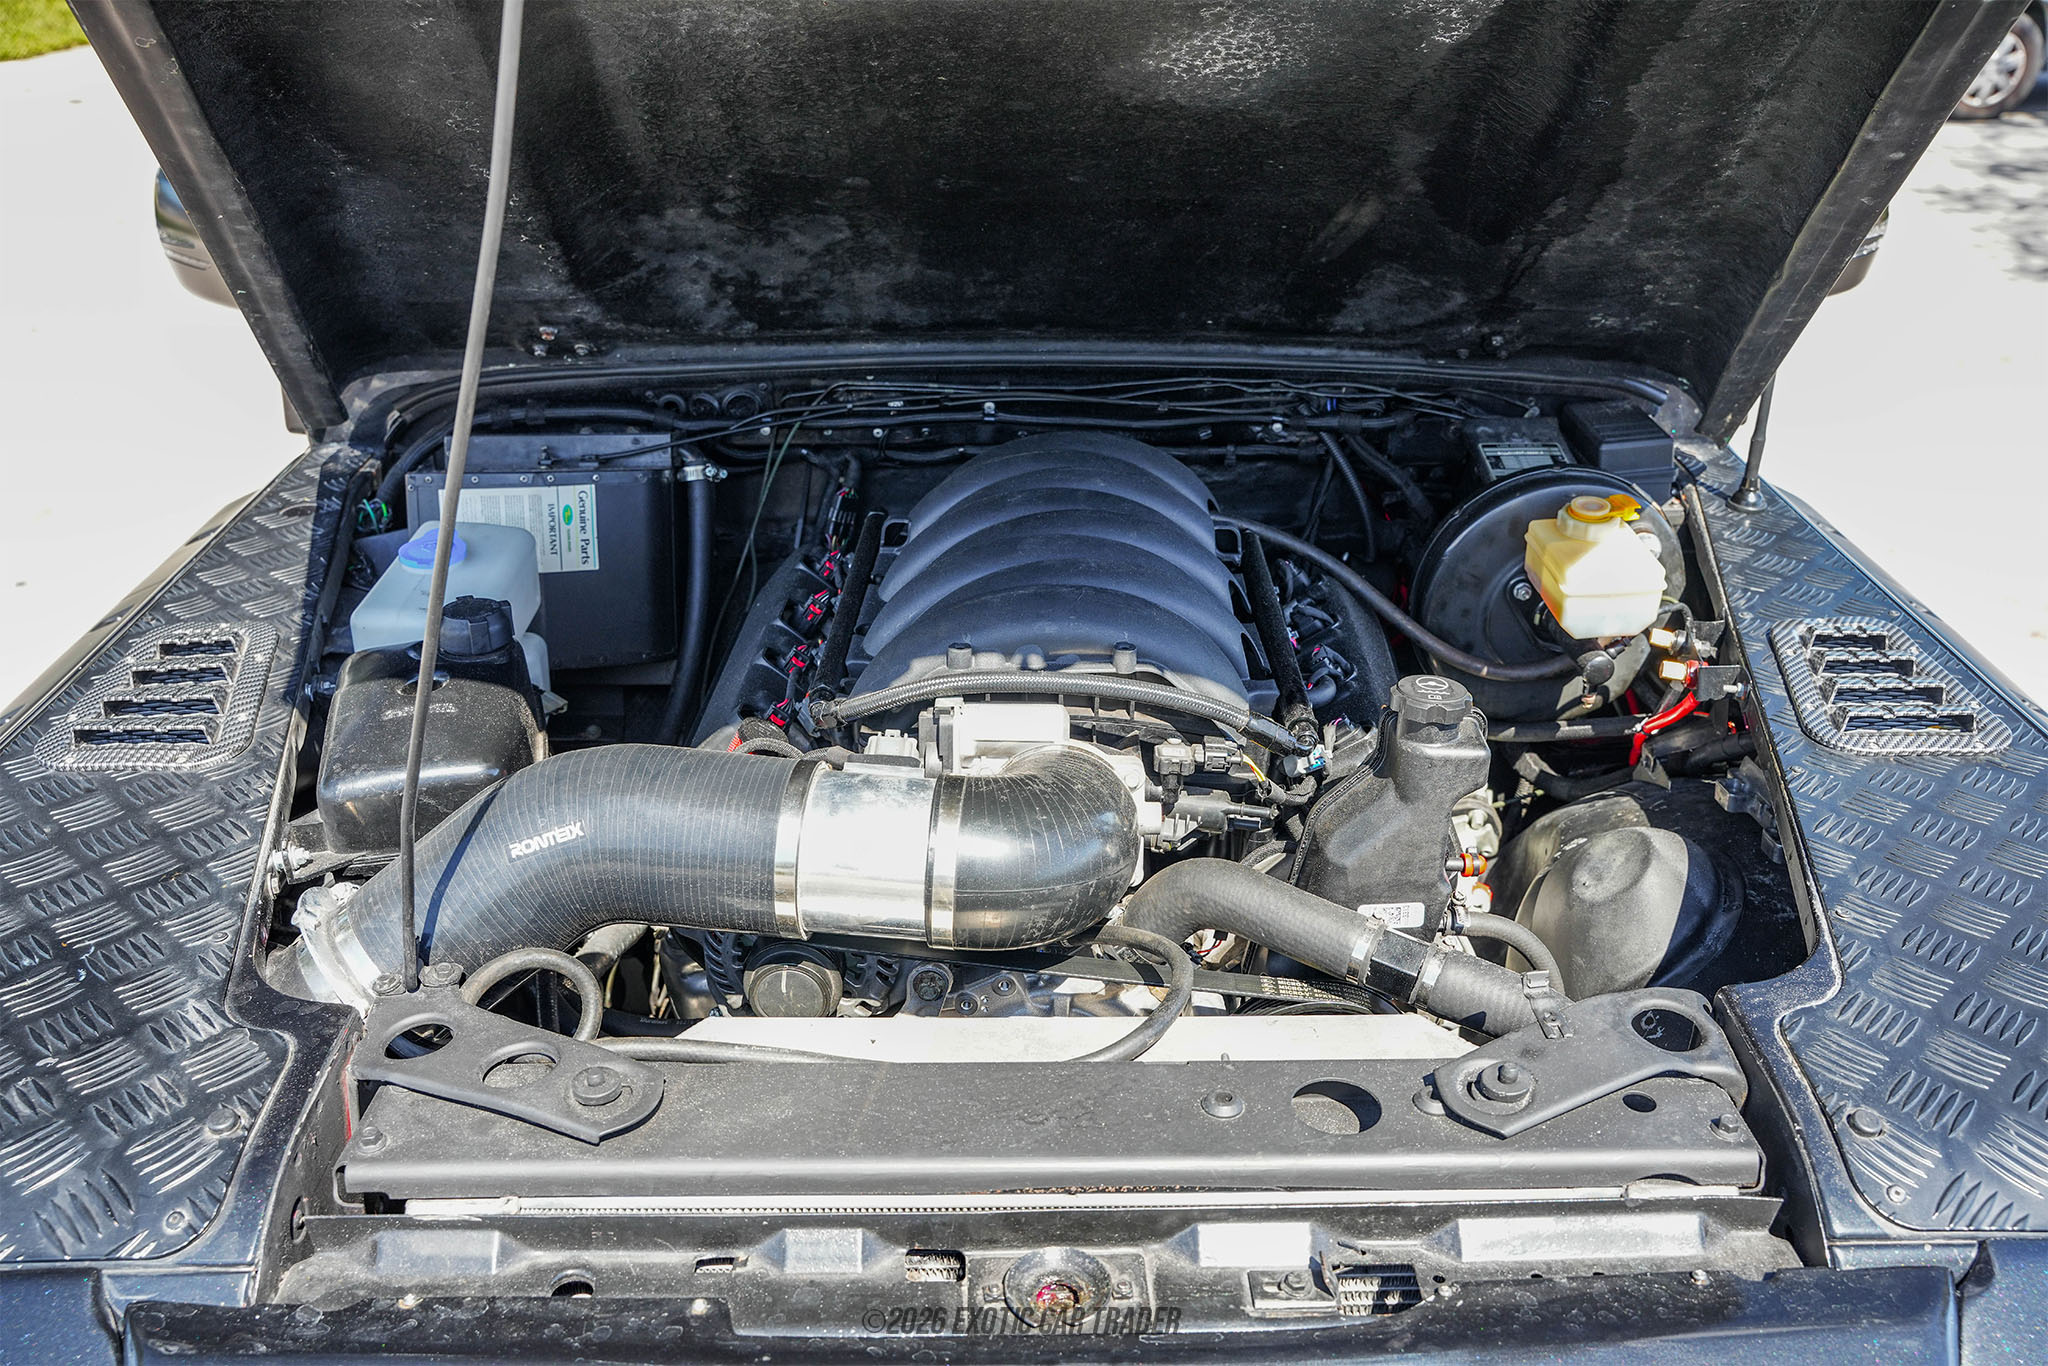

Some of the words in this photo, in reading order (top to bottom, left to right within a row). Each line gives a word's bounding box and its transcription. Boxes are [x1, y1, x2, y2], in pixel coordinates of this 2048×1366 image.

[547, 503, 559, 556] IMPORTANT
[577, 490, 591, 534] Genuine
[579, 538, 591, 565] Parts
